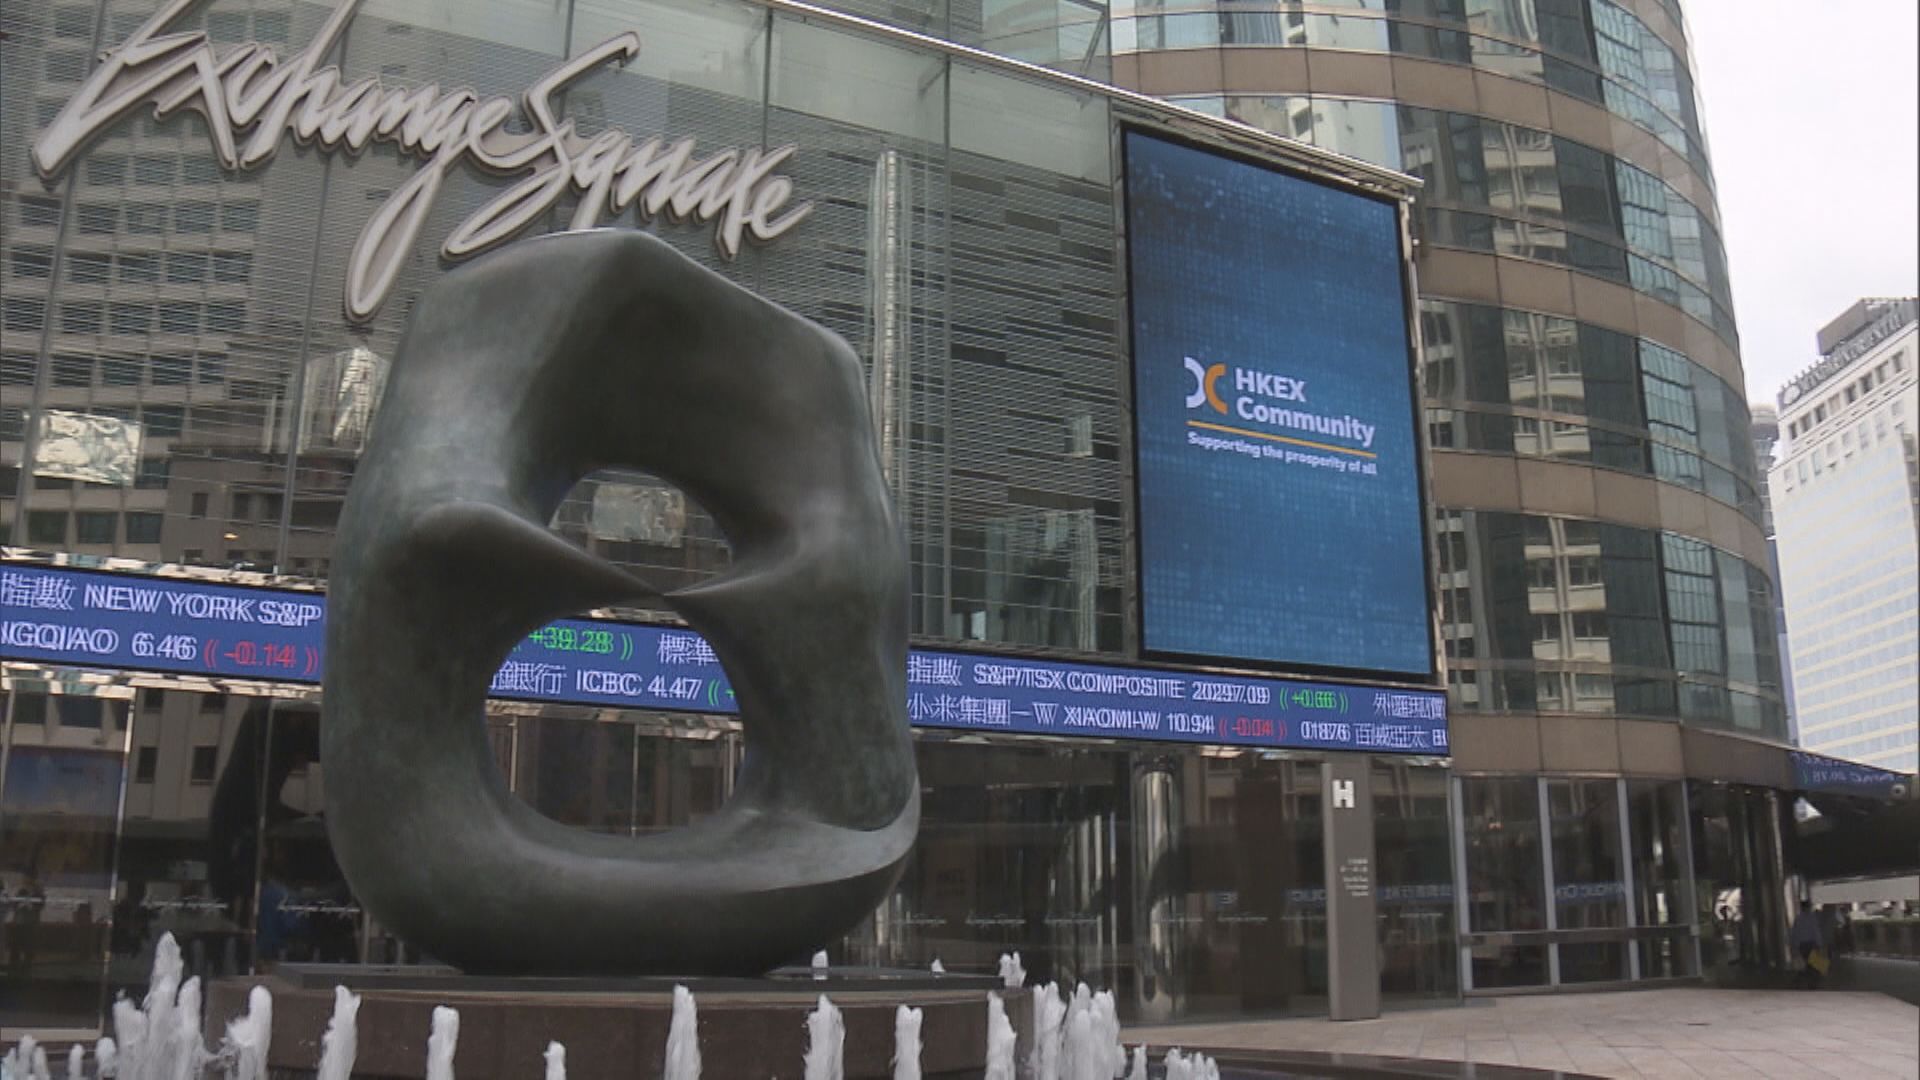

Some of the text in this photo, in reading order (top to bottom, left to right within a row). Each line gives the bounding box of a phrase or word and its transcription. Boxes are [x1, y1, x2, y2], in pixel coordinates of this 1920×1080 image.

[30, 0, 814, 324] Exchange Square
[1234, 366, 1307, 402] HKEX
[1236, 396, 1375, 448] Community
[1187, 431, 1377, 475] Supporting the prosperity of all
[83, 583, 162, 614] NEW
[164, 589, 257, 623] YORK
[257, 600, 321, 627] S&P
[132, 630, 198, 661] 6.46
[488, 660, 568, 695] 銀行
[575, 669, 643, 697] ICBC
[647, 675, 703, 700] 4.47
[1066, 671, 1187, 699] COMPOSITE
[1063, 704, 1161, 731] XIAOMI-W
[1300, 720, 1352, 743] 01876
[1332, 780, 1355, 809] H
